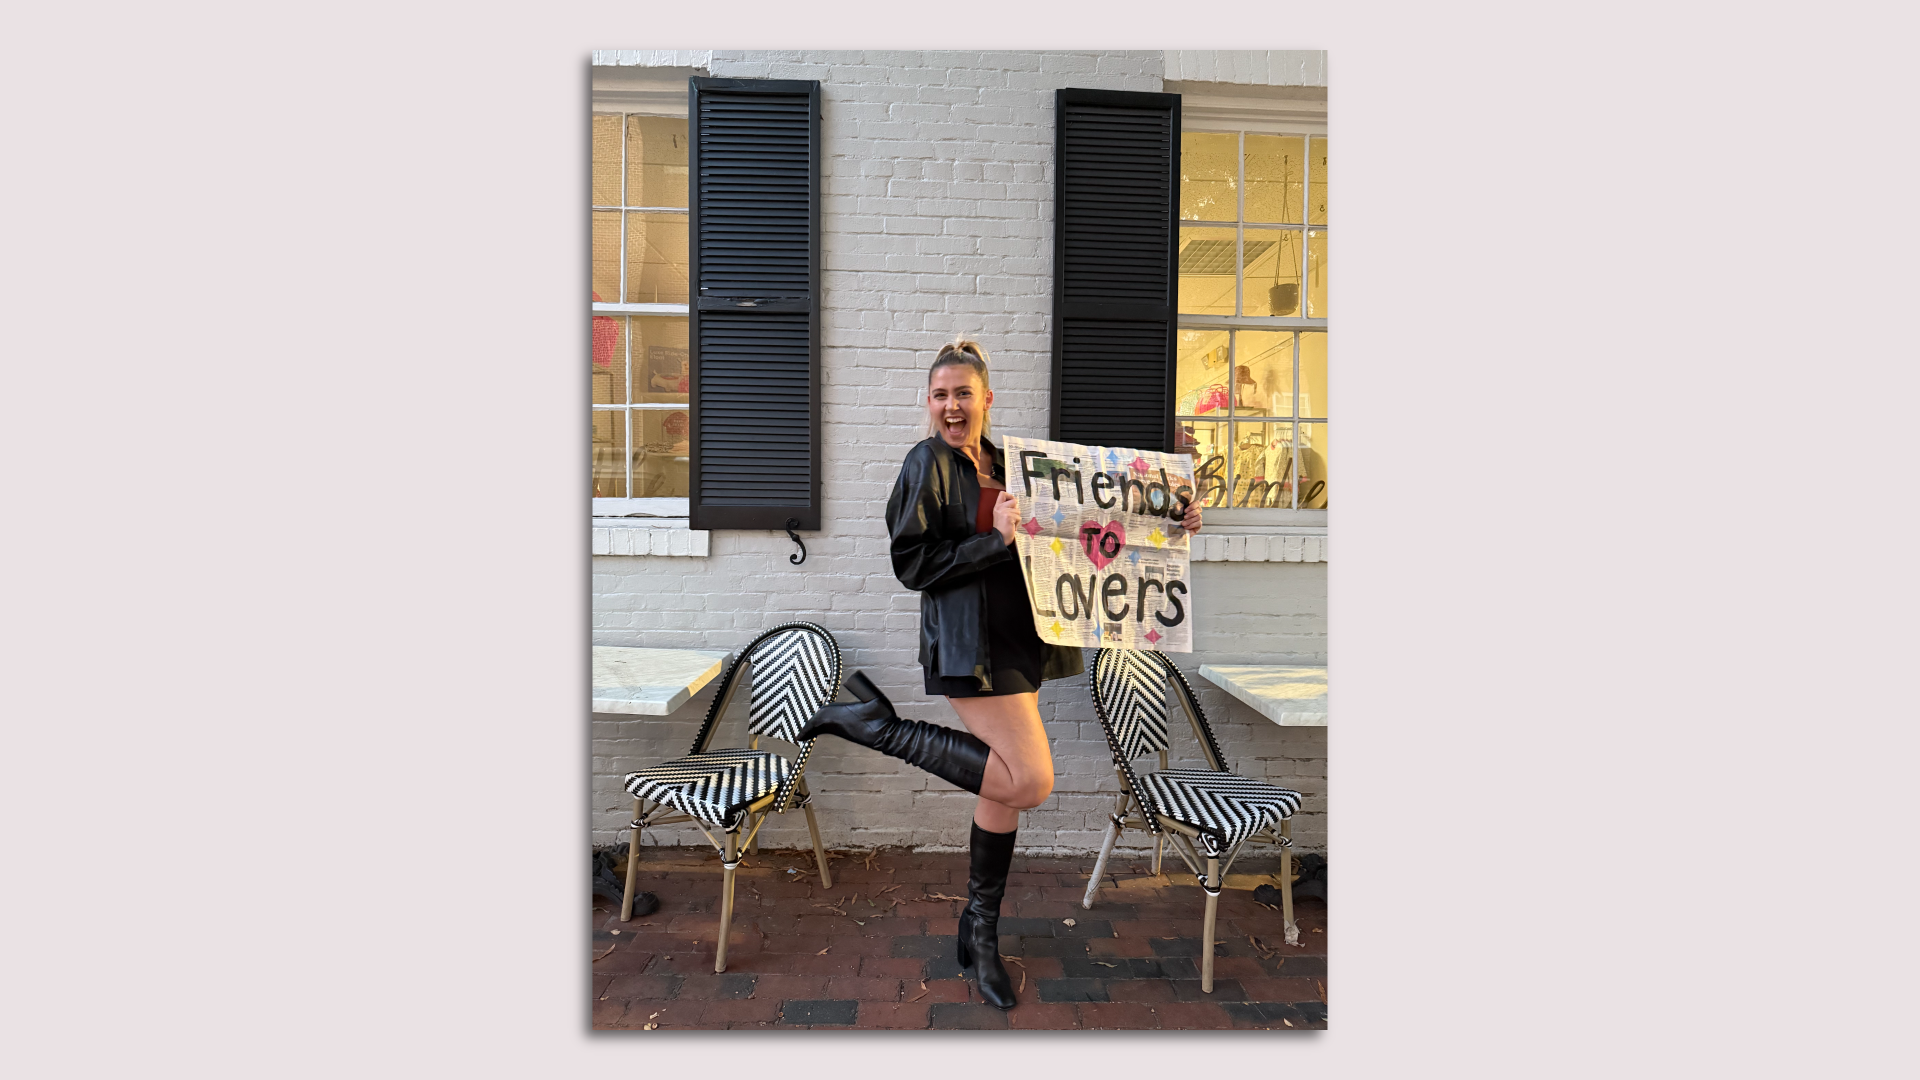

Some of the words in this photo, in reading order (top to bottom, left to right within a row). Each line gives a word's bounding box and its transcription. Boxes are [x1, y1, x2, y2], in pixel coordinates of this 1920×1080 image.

[1020, 450, 1194, 521] Friends
[1082, 527, 1121, 559] TO
[1025, 555, 1188, 627] Lovers
